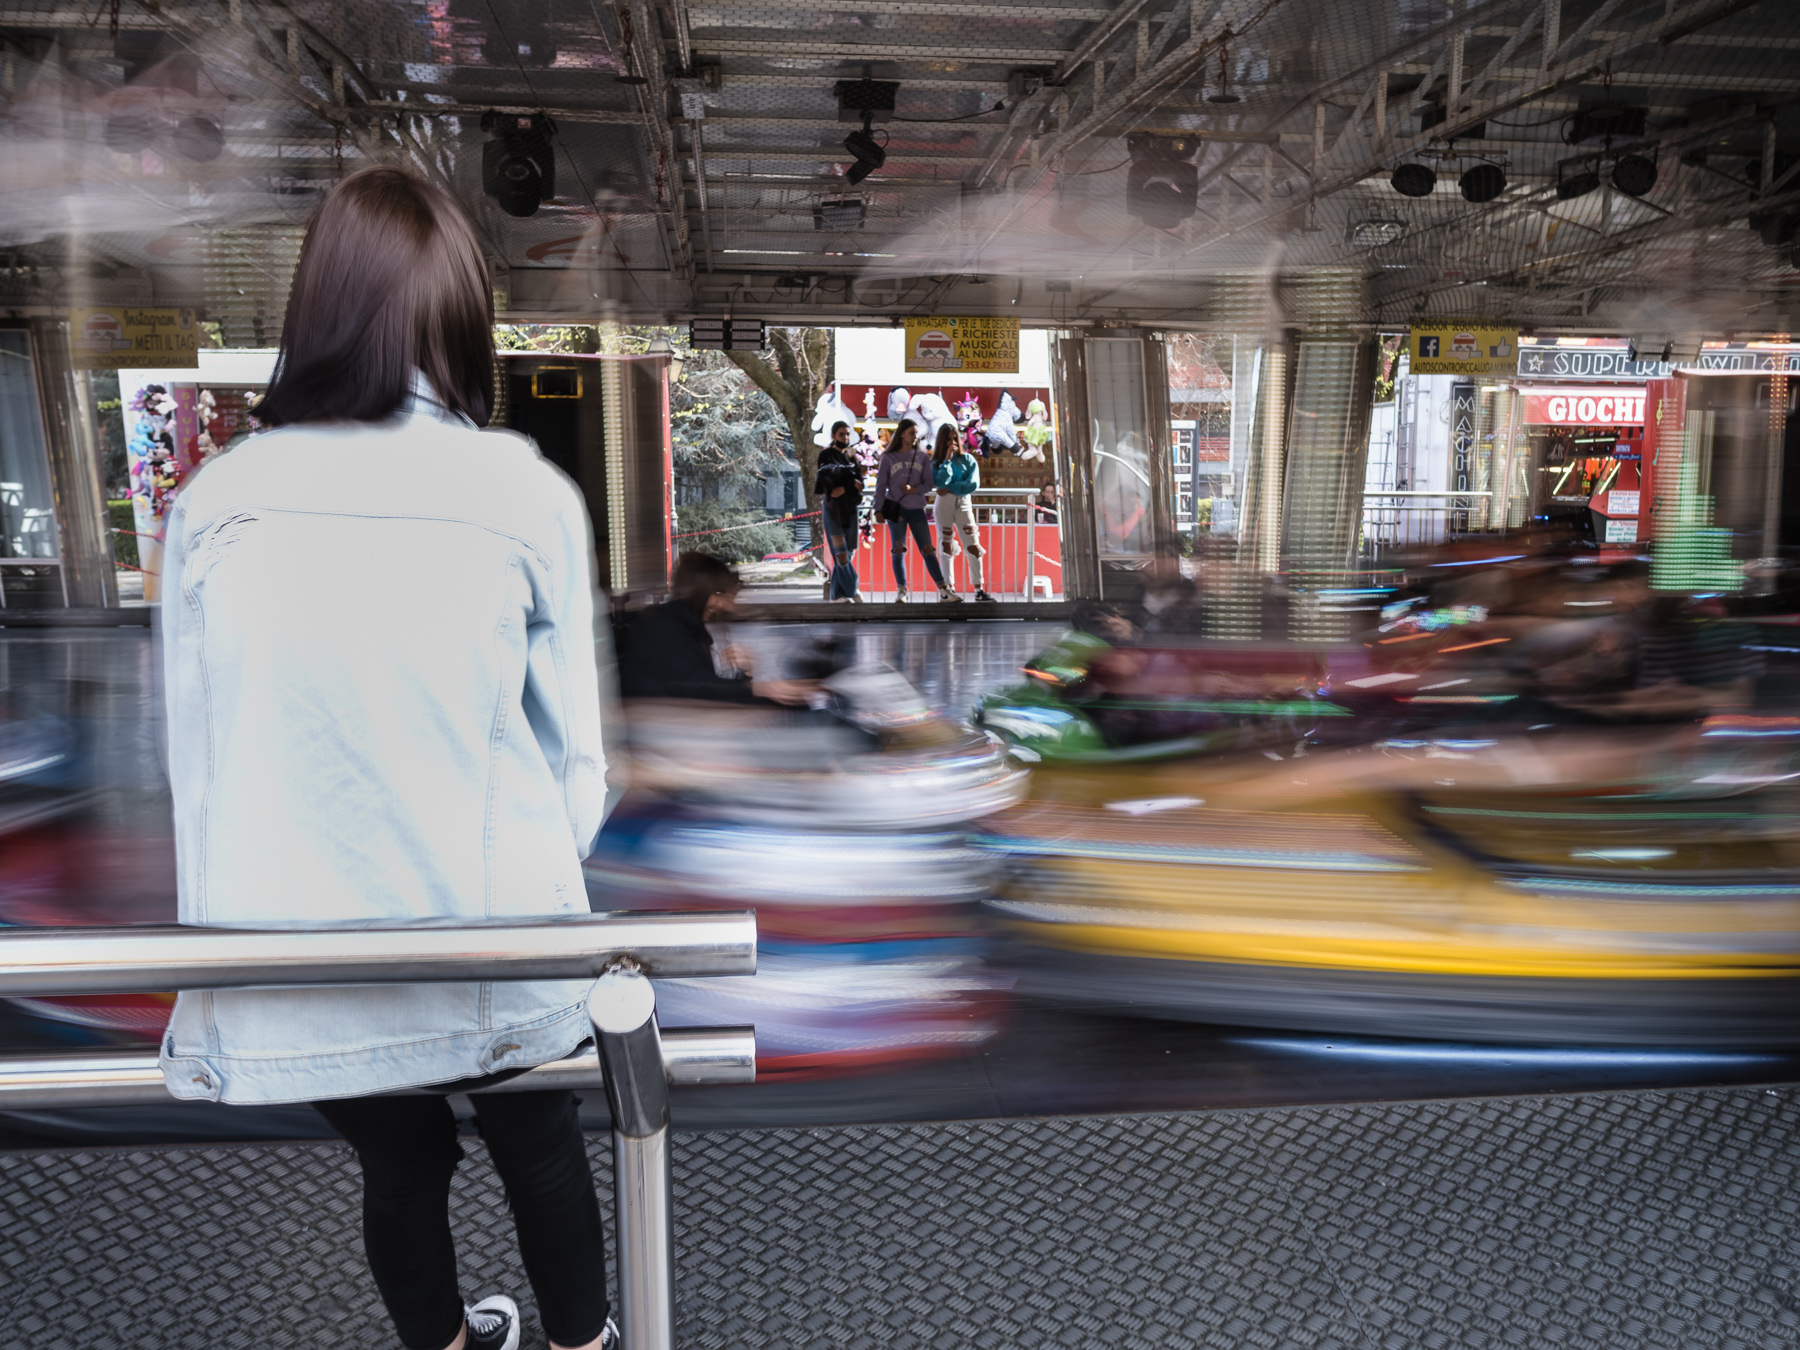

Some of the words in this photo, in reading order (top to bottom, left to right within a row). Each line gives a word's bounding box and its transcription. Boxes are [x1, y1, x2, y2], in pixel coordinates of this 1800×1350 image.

[123, 310, 176, 333] Instagram
[906, 318, 915, 328] SU
[917, 318, 949, 328] WHATSAPP
[959, 319, 971, 329] PER
[979, 319, 991, 329] TUE
[992, 319, 1018, 330] DEDICHE
[1411, 320, 1448, 331] FACEBOOK
[952, 329, 959, 338] E
[962, 329, 1018, 339] RICHIESTE
[135, 334, 162, 350] METTI
[165, 335, 173, 350] IL
[175, 335, 195, 350] TAG
[959, 340, 1018, 350] MUSICALI
[957, 350, 969, 358] AL
[973, 350, 1017, 359] NUMERO
[965, 361, 1016, 369] 353.42.79.123
[1548, 397, 1645, 422] GIOCHI
